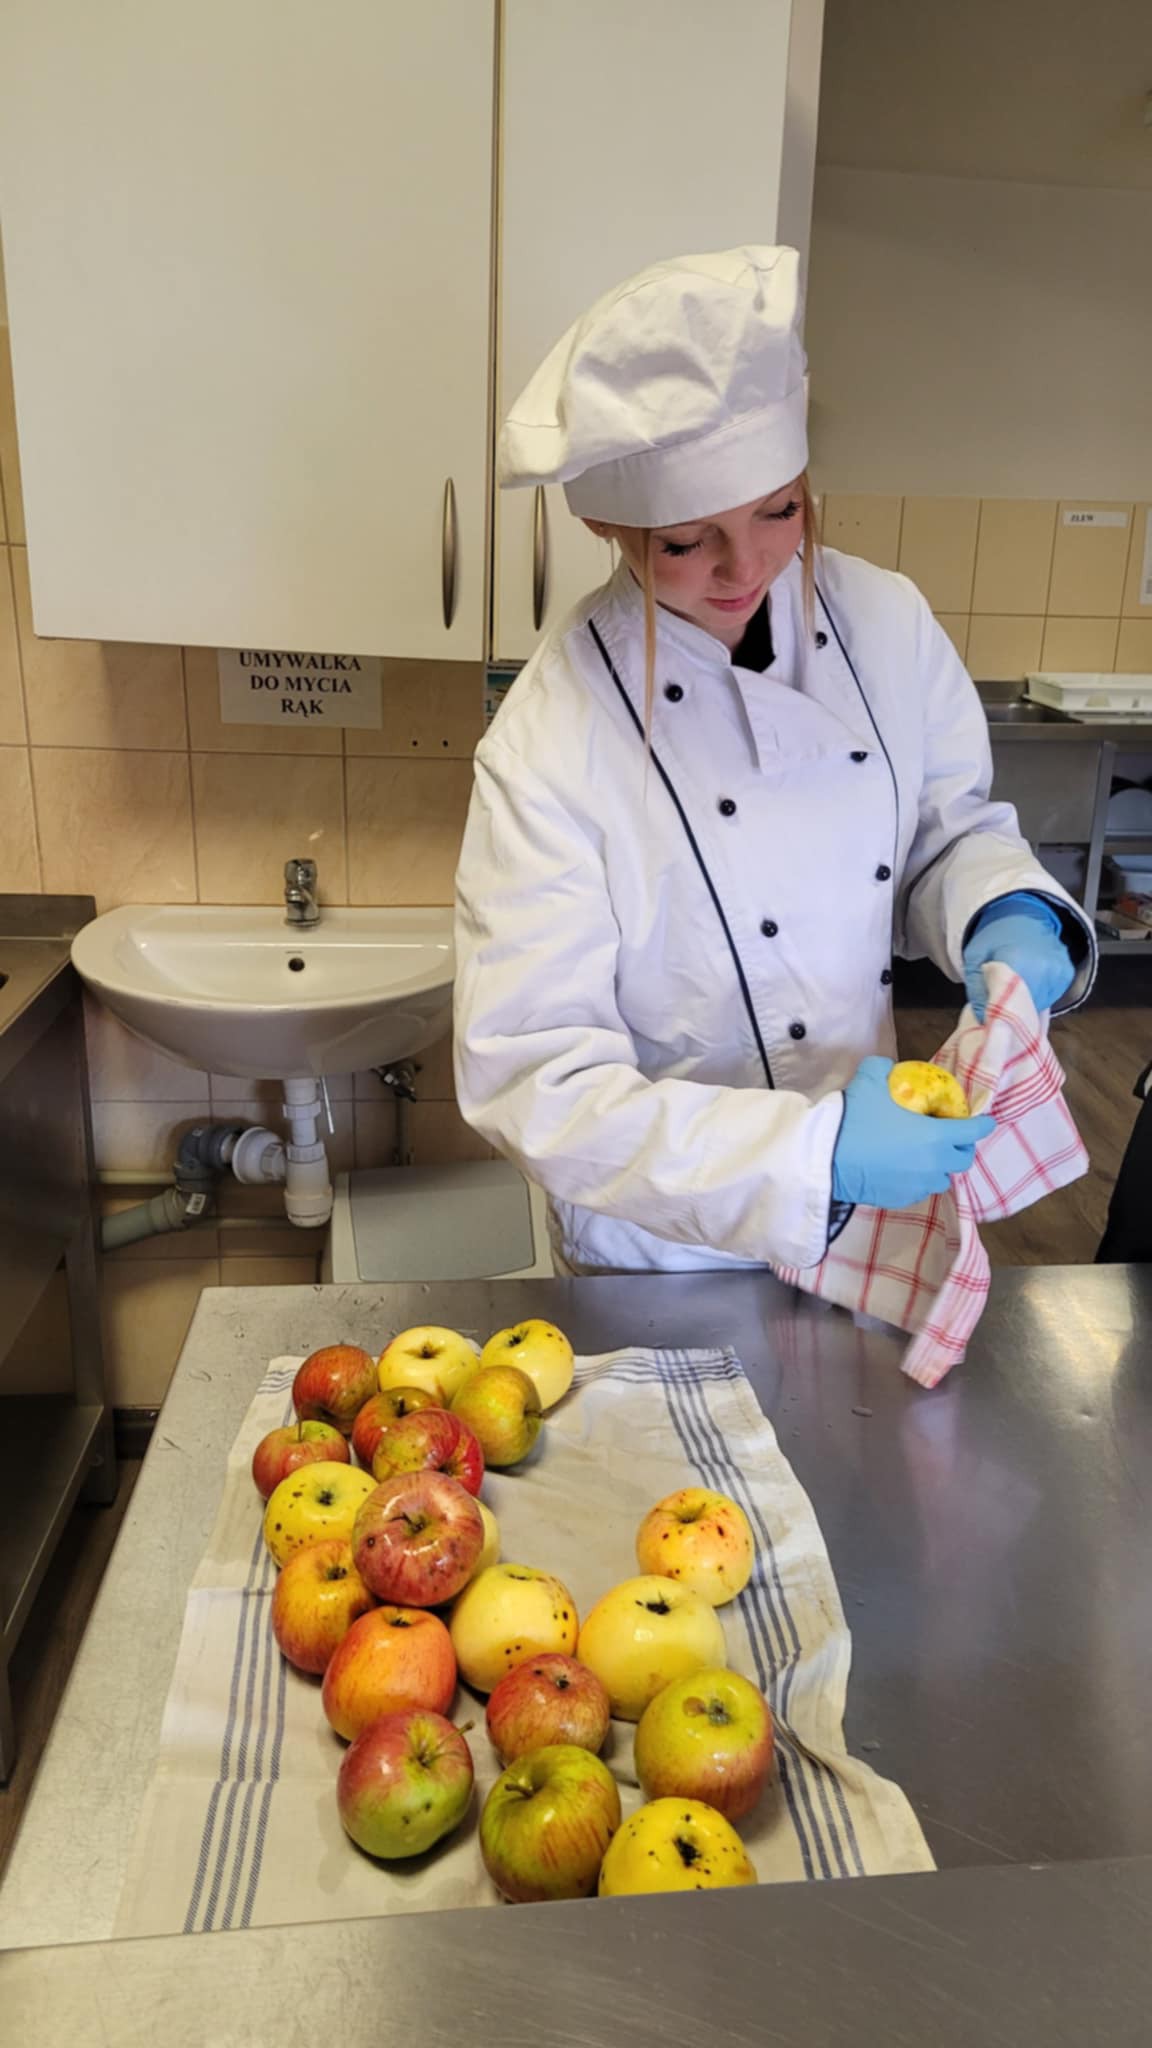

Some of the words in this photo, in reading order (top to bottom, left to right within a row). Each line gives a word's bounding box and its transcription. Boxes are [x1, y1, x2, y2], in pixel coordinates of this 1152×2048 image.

[239, 651, 361, 671] UMYWALKA
[250, 675, 279, 691] DO
[285, 676, 352, 693] MYCIA
[280, 698, 324, 718] RĄK
